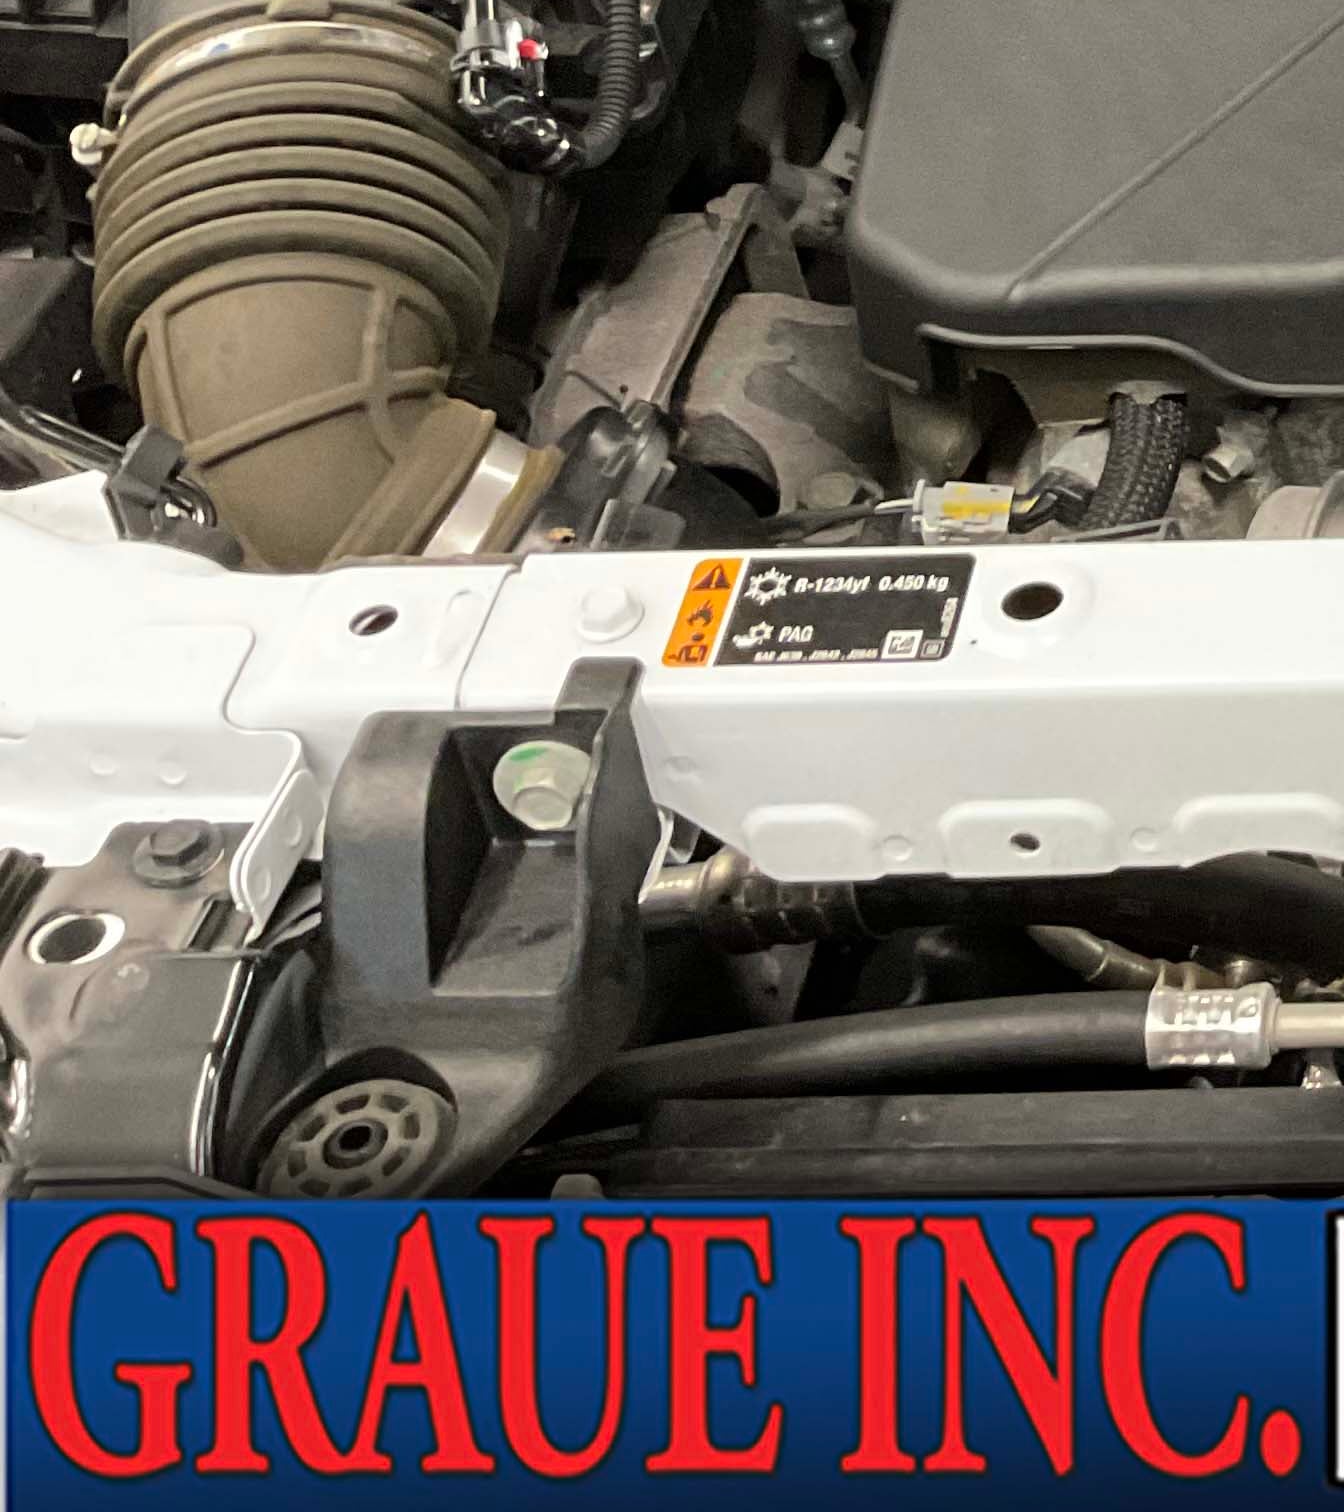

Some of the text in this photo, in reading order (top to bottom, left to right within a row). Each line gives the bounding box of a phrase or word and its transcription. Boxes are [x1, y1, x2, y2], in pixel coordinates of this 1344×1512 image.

[794, 574, 950, 595] R-1234yf 0.450 kg
[778, 625, 814, 643] PAG
